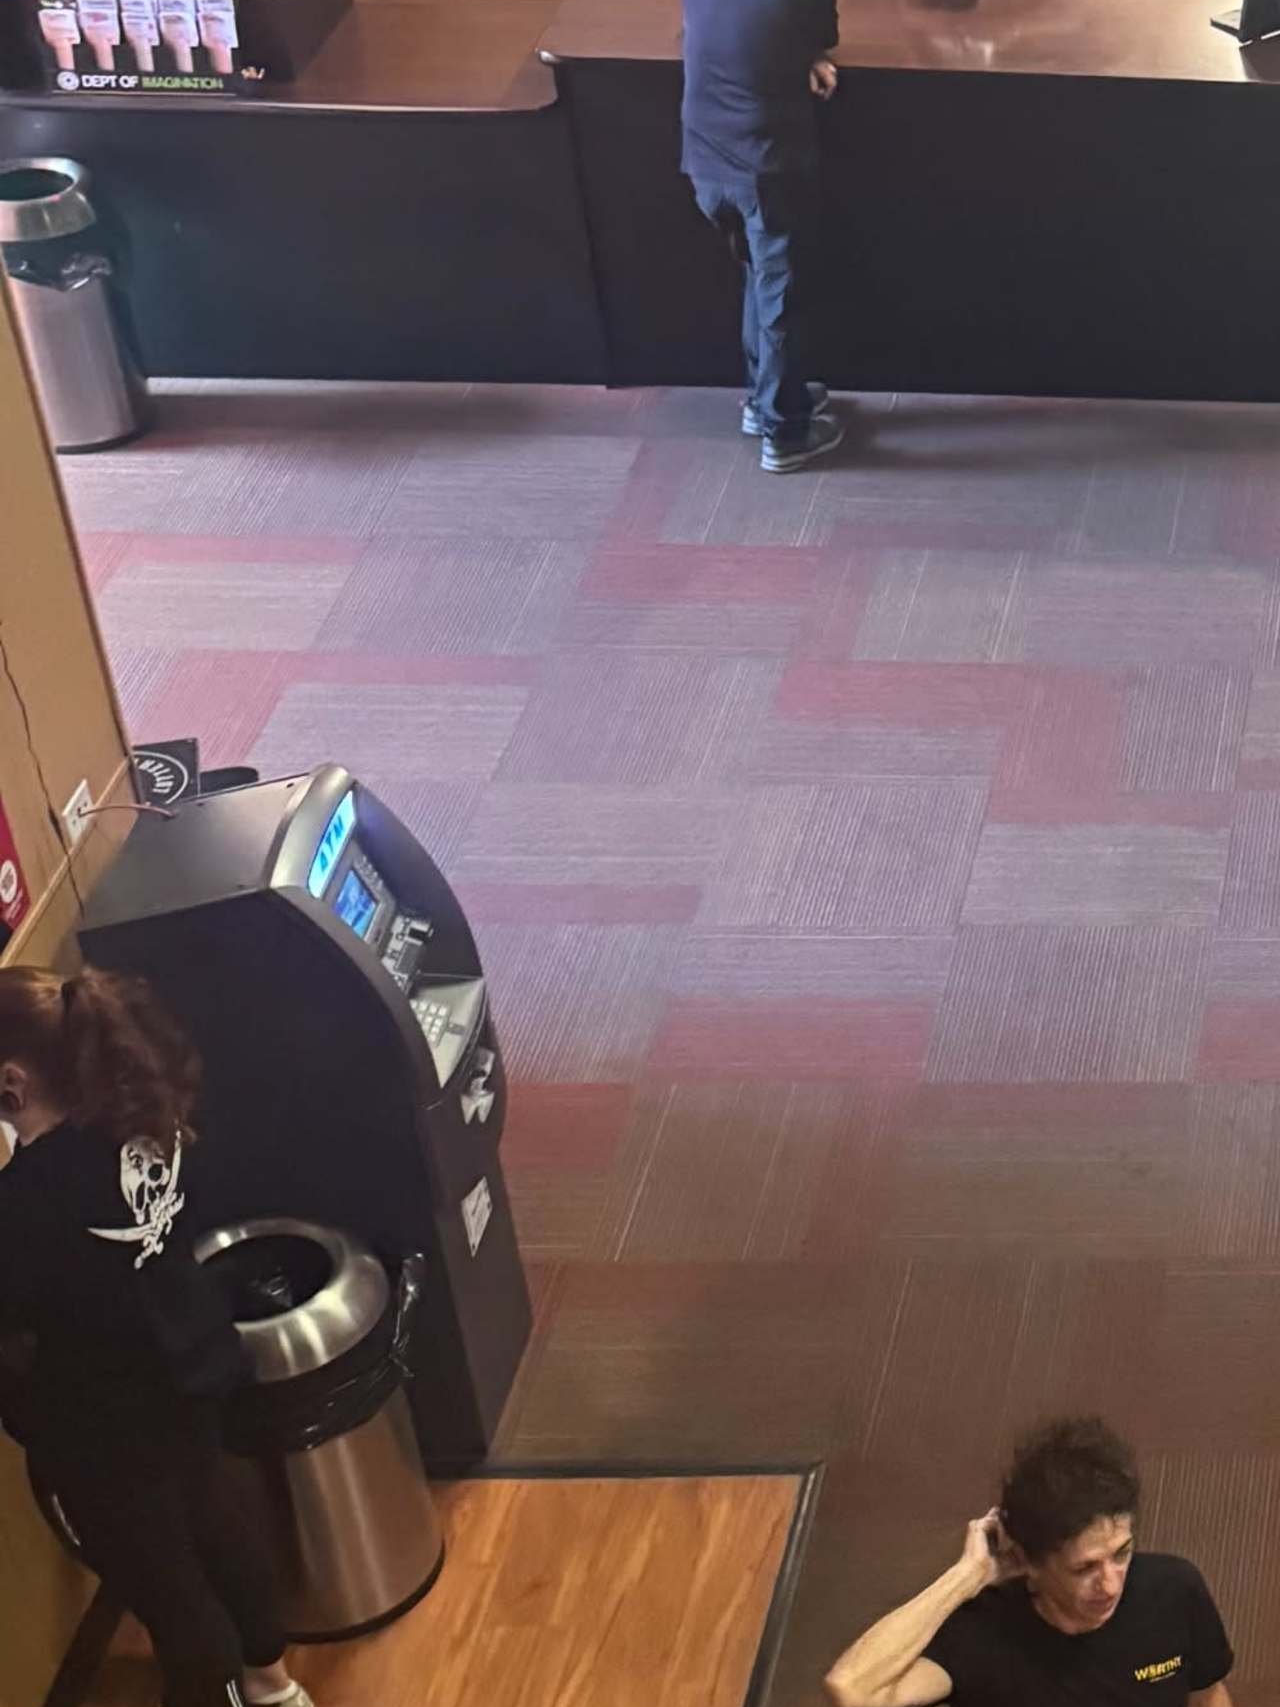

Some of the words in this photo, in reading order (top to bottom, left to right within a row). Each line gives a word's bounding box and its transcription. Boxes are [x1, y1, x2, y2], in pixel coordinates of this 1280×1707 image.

[81, 75, 117, 88] DEPT
[119, 75, 140, 88] OF
[318, 815, 344, 872] ATM
